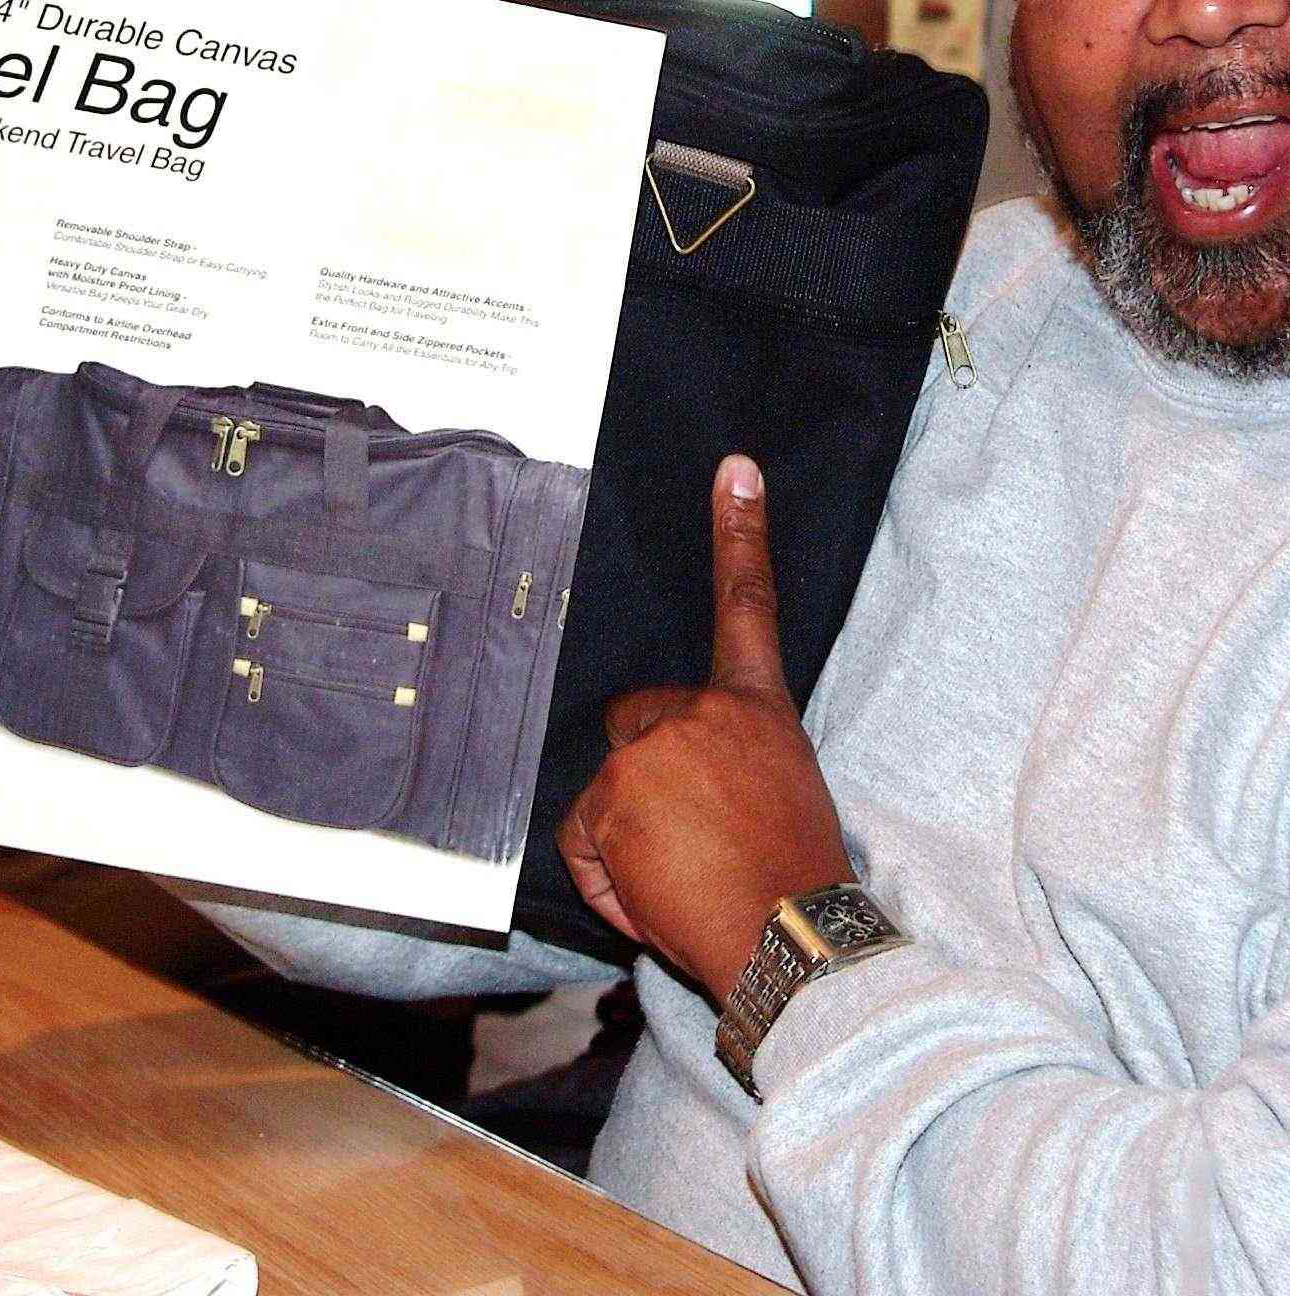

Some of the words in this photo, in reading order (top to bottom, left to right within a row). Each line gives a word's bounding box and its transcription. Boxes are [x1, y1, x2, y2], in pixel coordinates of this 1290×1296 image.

[37, 3, 164, 51] Durable
[175, 29, 298, 75] Canvas
[75, 52, 229, 149] Bag
[67, 130, 143, 166] Travel
[151, 147, 205, 182] Bag
[55, 217, 112, 237] Removable
[114, 229, 161, 246] Shoulder
[163, 238, 191, 253] Strap
[49, 256, 80, 271] Heavy
[83, 261, 106, 276] Duty
[110, 266, 148, 282] Canvas
[71, 272, 116, 288] Moisture
[118, 280, 148, 294] Proof
[319, 266, 356, 283] Quality
[358, 274, 407, 291] Hardware
[409, 284, 430, 296] and
[432, 287, 481, 304] Attractive
[483, 296, 525, 312] Accents
[39, 317, 110, 339] Compartment
[110, 330, 172, 350] Restrictions
[41, 305, 91, 322] Conforms
[94, 315, 105, 325] to
[142, 323, 193, 341] Overhead
[311, 315, 339, 329] Extra
[340, 321, 369, 335] Front
[370, 328, 391, 338] and
[392, 330, 414, 343] Side
[417, 335, 464, 352] Zippered
[465, 343, 506, 360] Pockets
